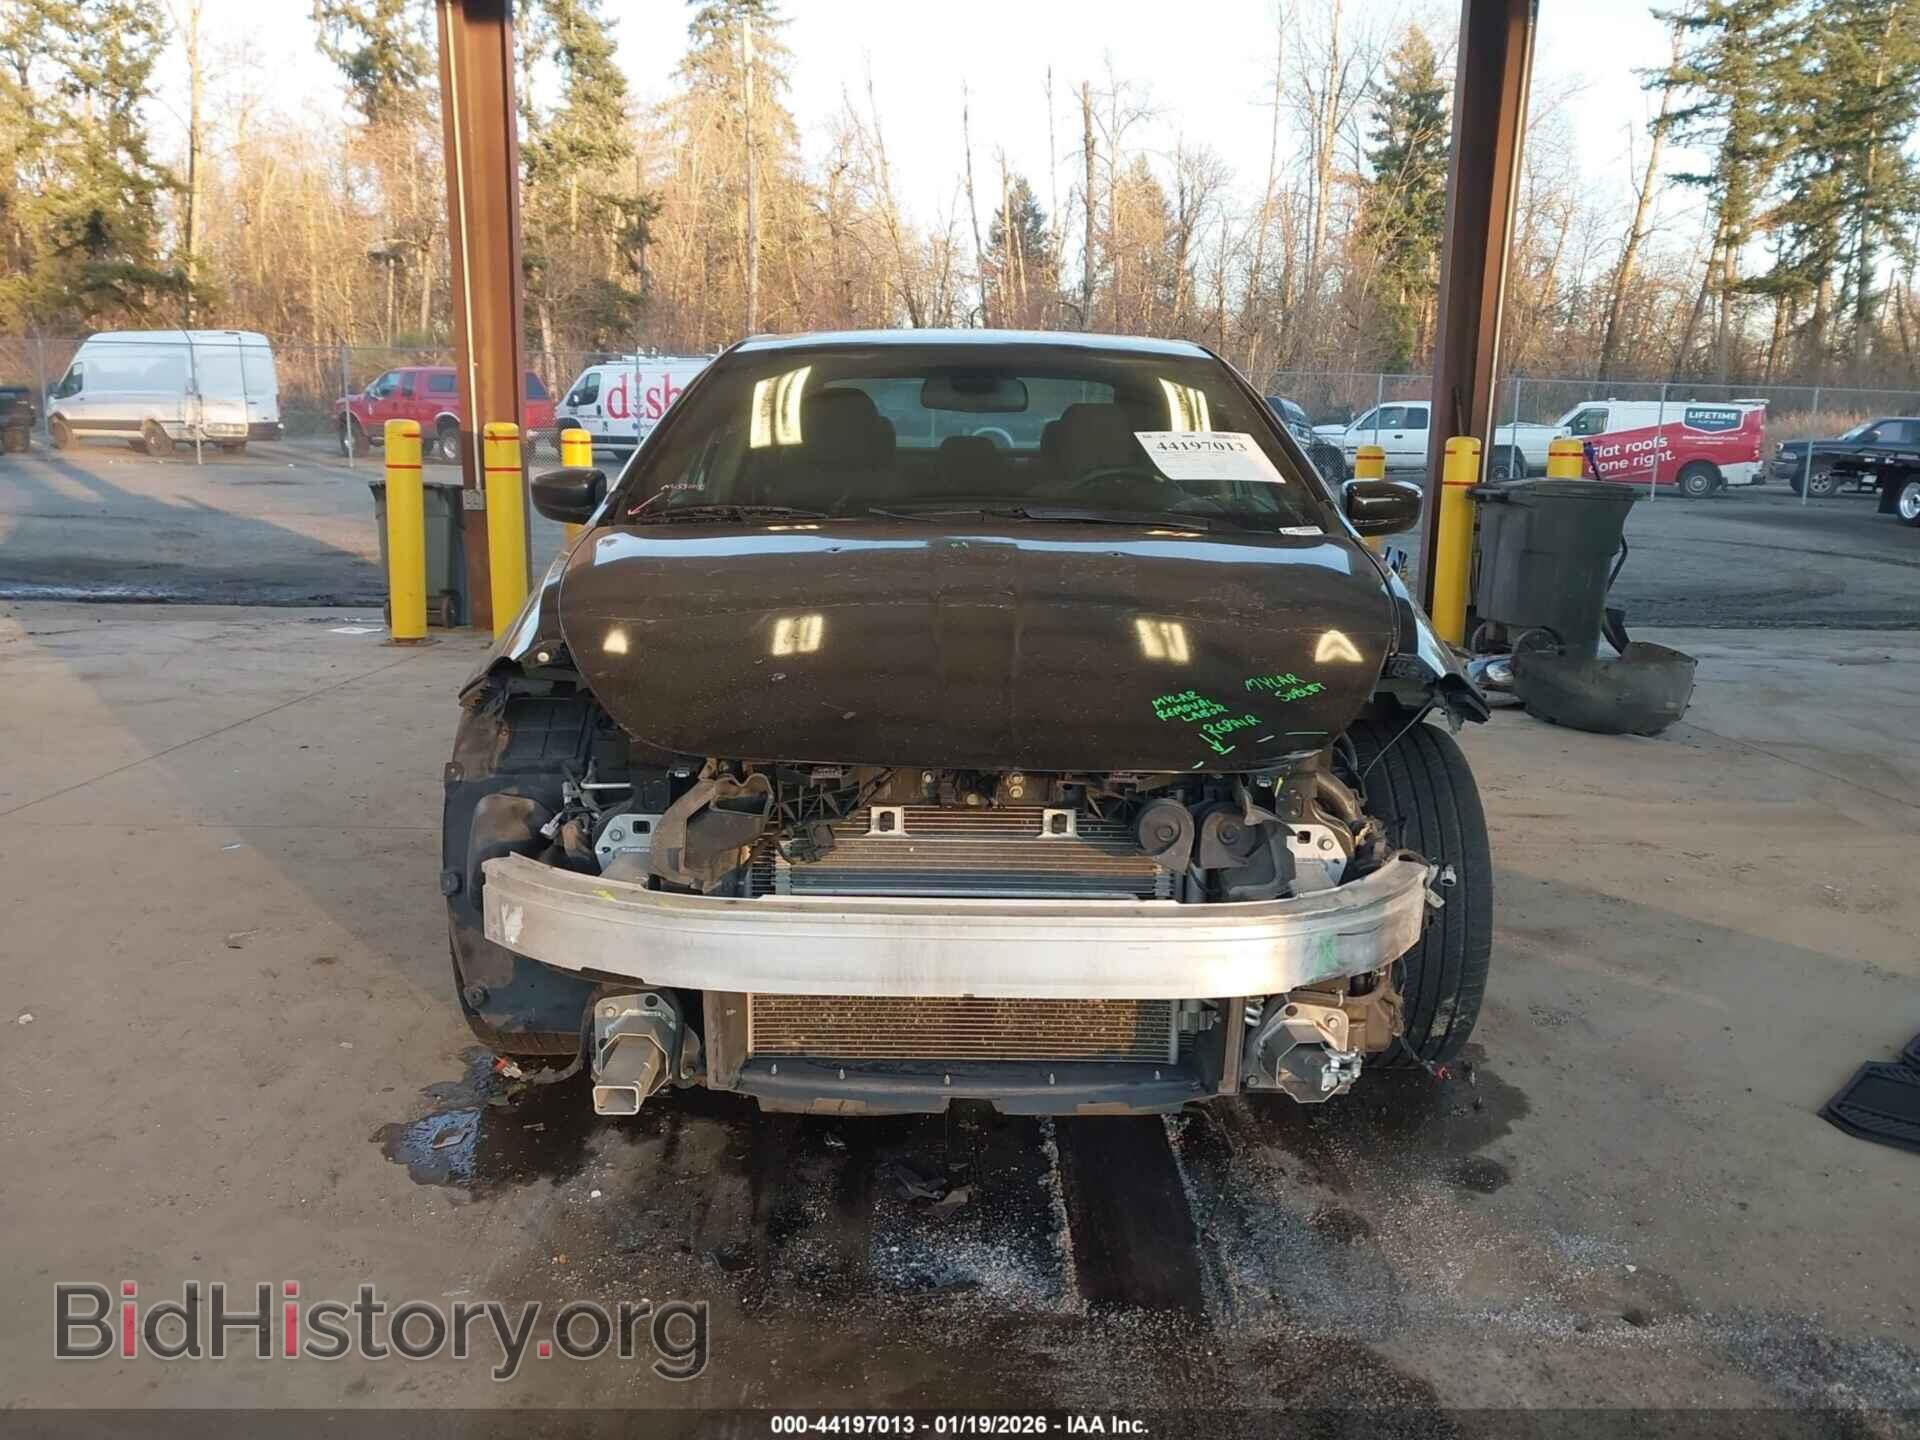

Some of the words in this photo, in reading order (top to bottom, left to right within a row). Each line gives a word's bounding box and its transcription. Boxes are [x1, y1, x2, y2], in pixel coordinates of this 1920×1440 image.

[606, 370, 684, 420] dish
[1688, 411, 1737, 421] LIFETIME
[1156, 439, 1248, 452] 44197013
[1625, 436, 1669, 453] roofs
[1244, 672, 1306, 692] MYLAR
[1275, 682, 1327, 702] SUBLET
[1152, 690, 1201, 710] MYLAR
[1156, 699, 1218, 721] REMOVAL
[1181, 703, 1230, 722] LABOR
[1202, 714, 1263, 740] REPAIR
